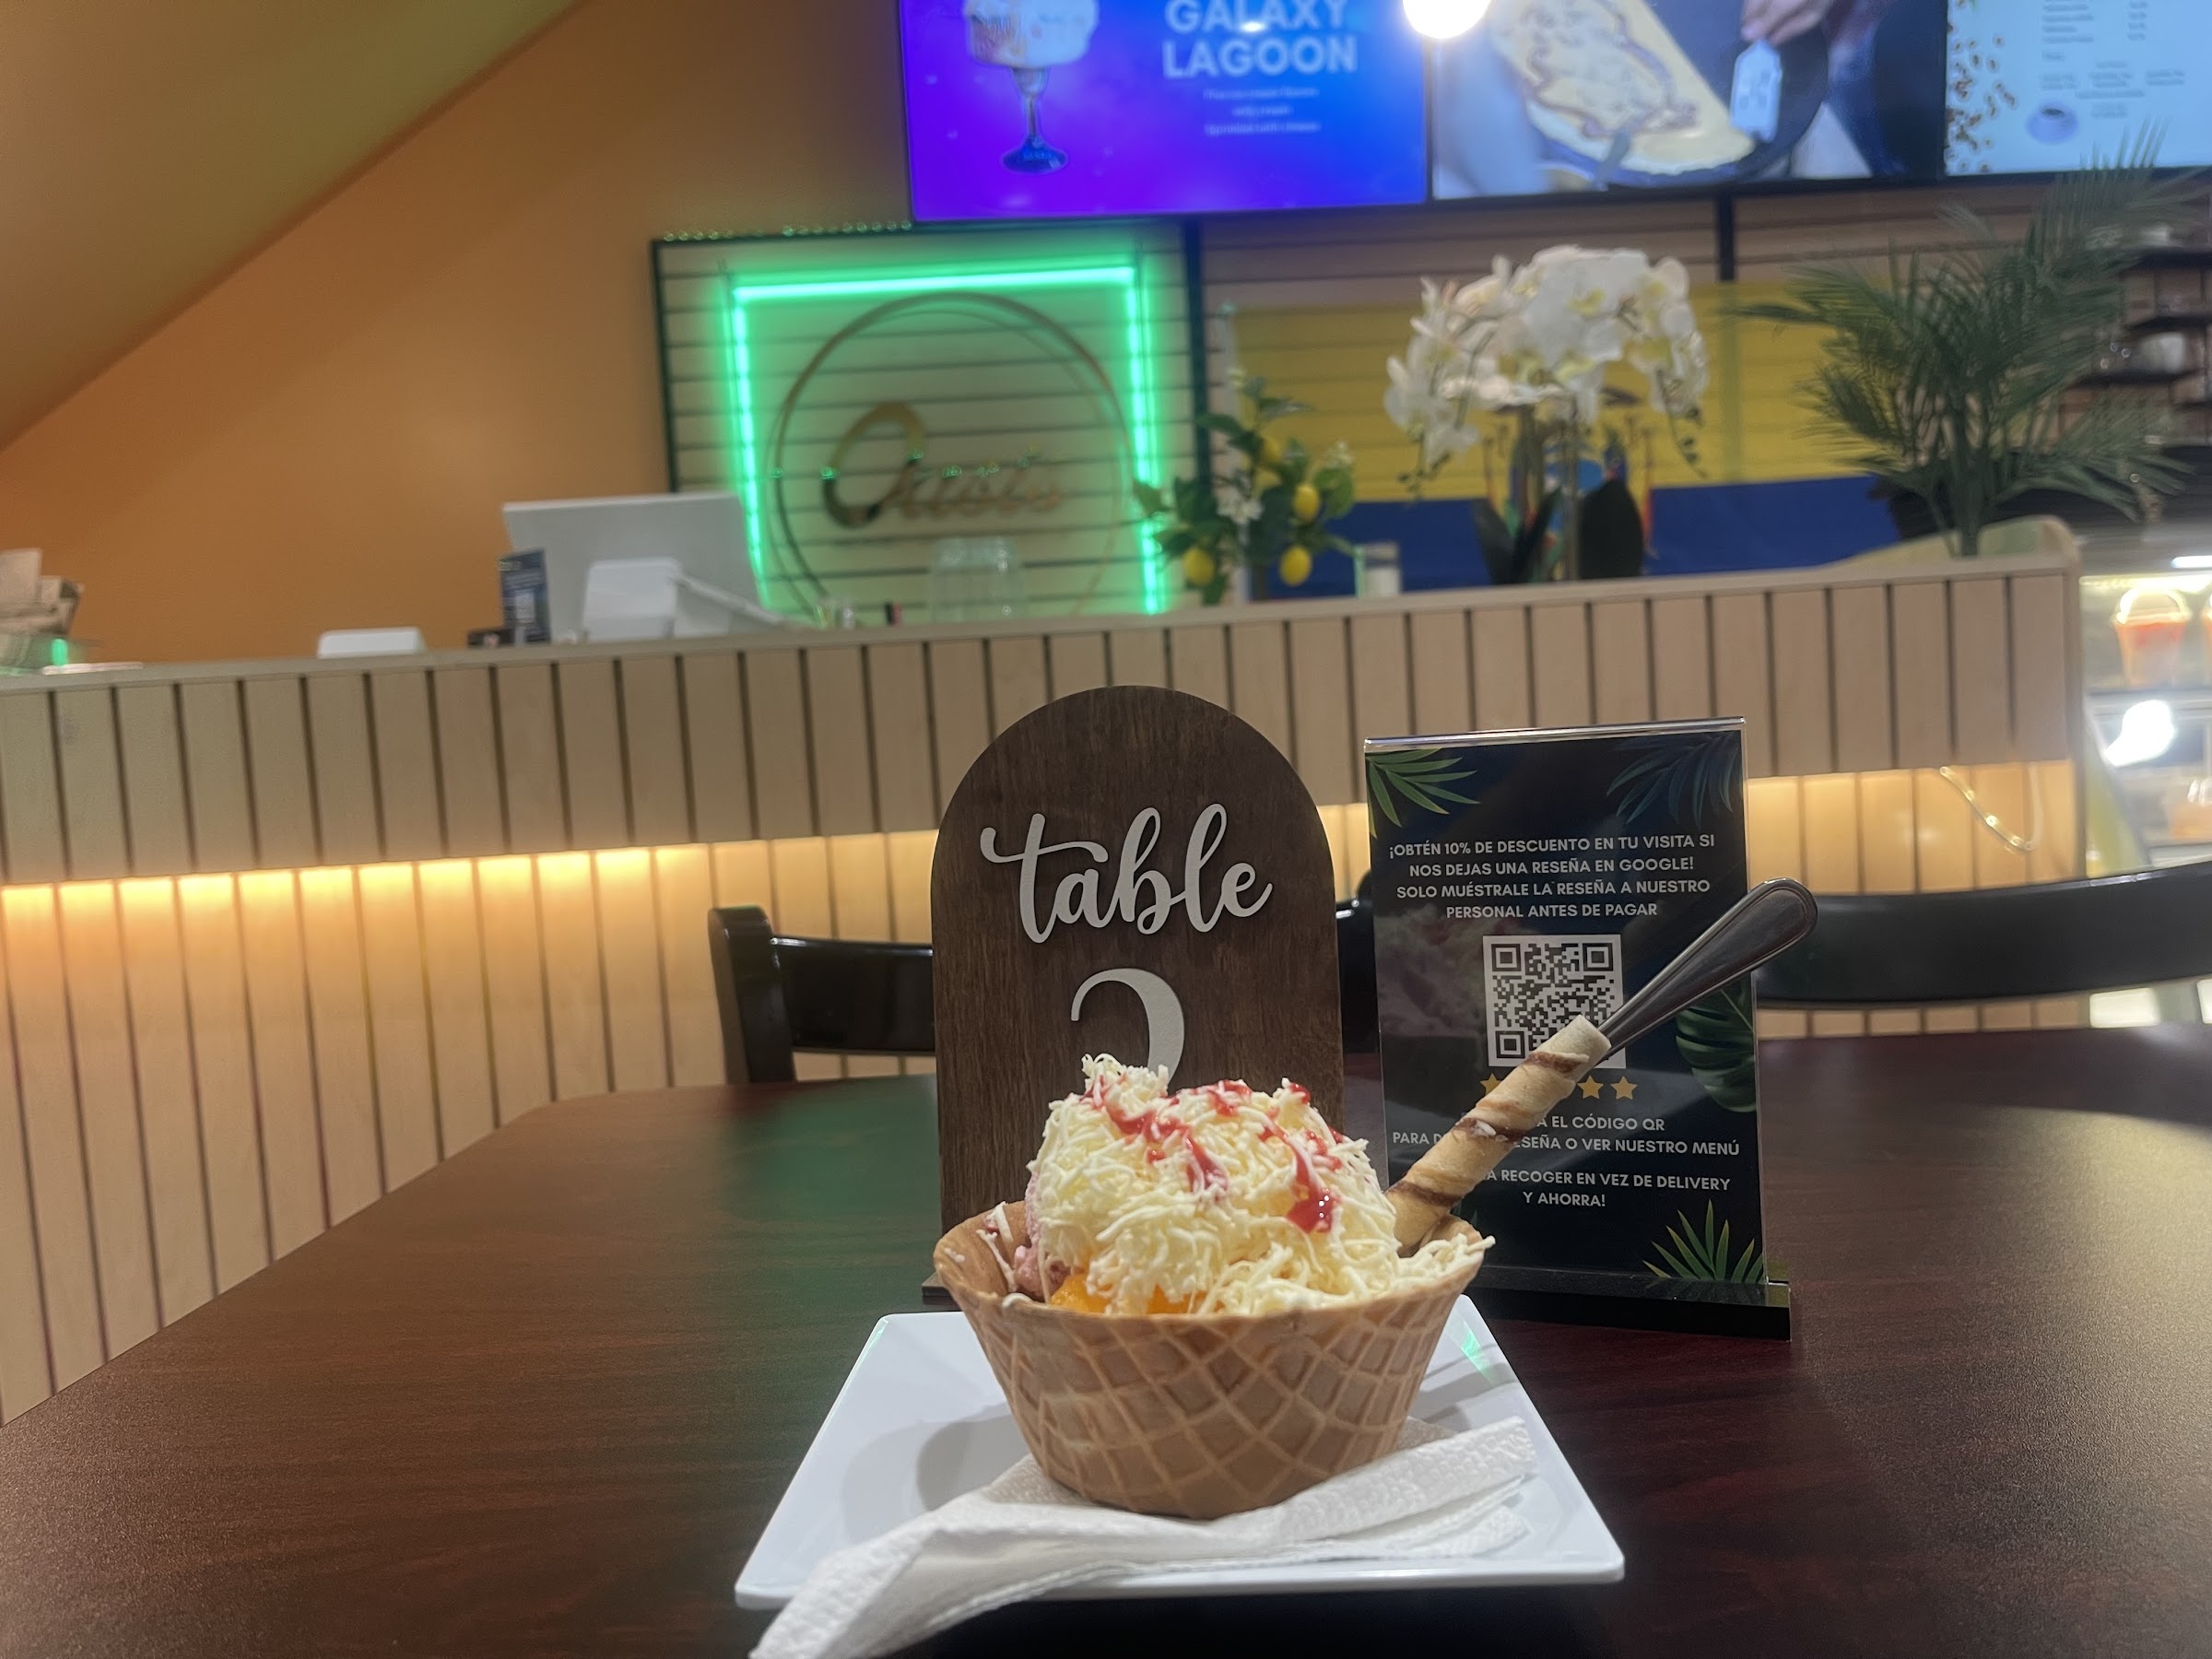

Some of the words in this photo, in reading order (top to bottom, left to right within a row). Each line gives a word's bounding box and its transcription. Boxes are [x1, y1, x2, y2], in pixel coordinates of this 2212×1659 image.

[1164, 0, 1348, 34] GALAXY
[1162, 36, 1358, 78] LAGOON
[1390, 840, 1441, 859] ¡OBTÉN
[1445, 842, 1471, 854] 10%
[1475, 841, 1493, 853] DE
[1497, 839, 1590, 853] DESCUENTO
[1594, 837, 1613, 850] EN
[1618, 836, 1639, 849] TU
[1642, 835, 1695, 849] VISITA
[1699, 834, 1715, 847] SI
[980, 804, 1273, 944] table
[1409, 865, 1442, 877] NOS
[1445, 863, 1492, 876] DEJAS
[1495, 862, 1528, 875] UNA
[1532, 857, 1591, 874] RESEÑA
[1594, 859, 1615, 872] EN
[1618, 856, 1694, 872] GOOGLE!
[1396, 886, 1438, 899] SOLO
[1441, 881, 1529, 898] MUÉSTRALE
[1533, 883, 1553, 896] LA
[1557, 879, 1616, 895] RESEÑA
[1620, 881, 1632, 894] A
[1636, 879, 1711, 893] NUESTRO
[1446, 906, 1524, 919] PERSONAL
[1527, 904, 1578, 917] ANTES
[1582, 904, 1601, 917] DE
[1605, 903, 1657, 916] PAGAR
[1551, 1115, 1568, 1128] EL
[1571, 1113, 1638, 1130] CÓDIGO
[1642, 1118, 1665, 1131] QR
[1393, 1132, 1430, 1145] PARA
[1514, 1134, 1561, 1149] SEÑA
[1565, 1137, 1578, 1150] O
[1582, 1138, 1611, 1151] VER
[1615, 1139, 1688, 1154] NUESTRO
[1692, 1139, 1740, 1156] MENÚ
[1501, 1169, 1572, 1184] RECOGER
[1576, 1172, 1595, 1185] EN
[1599, 1173, 1630, 1187] VEZ
[1633, 1174, 1653, 1187] DE
[1656, 1175, 1731, 1191] DELIVERY
[1523, 1192, 1533, 1204] Y
[1537, 1193, 1606, 1207] AHORRA!
